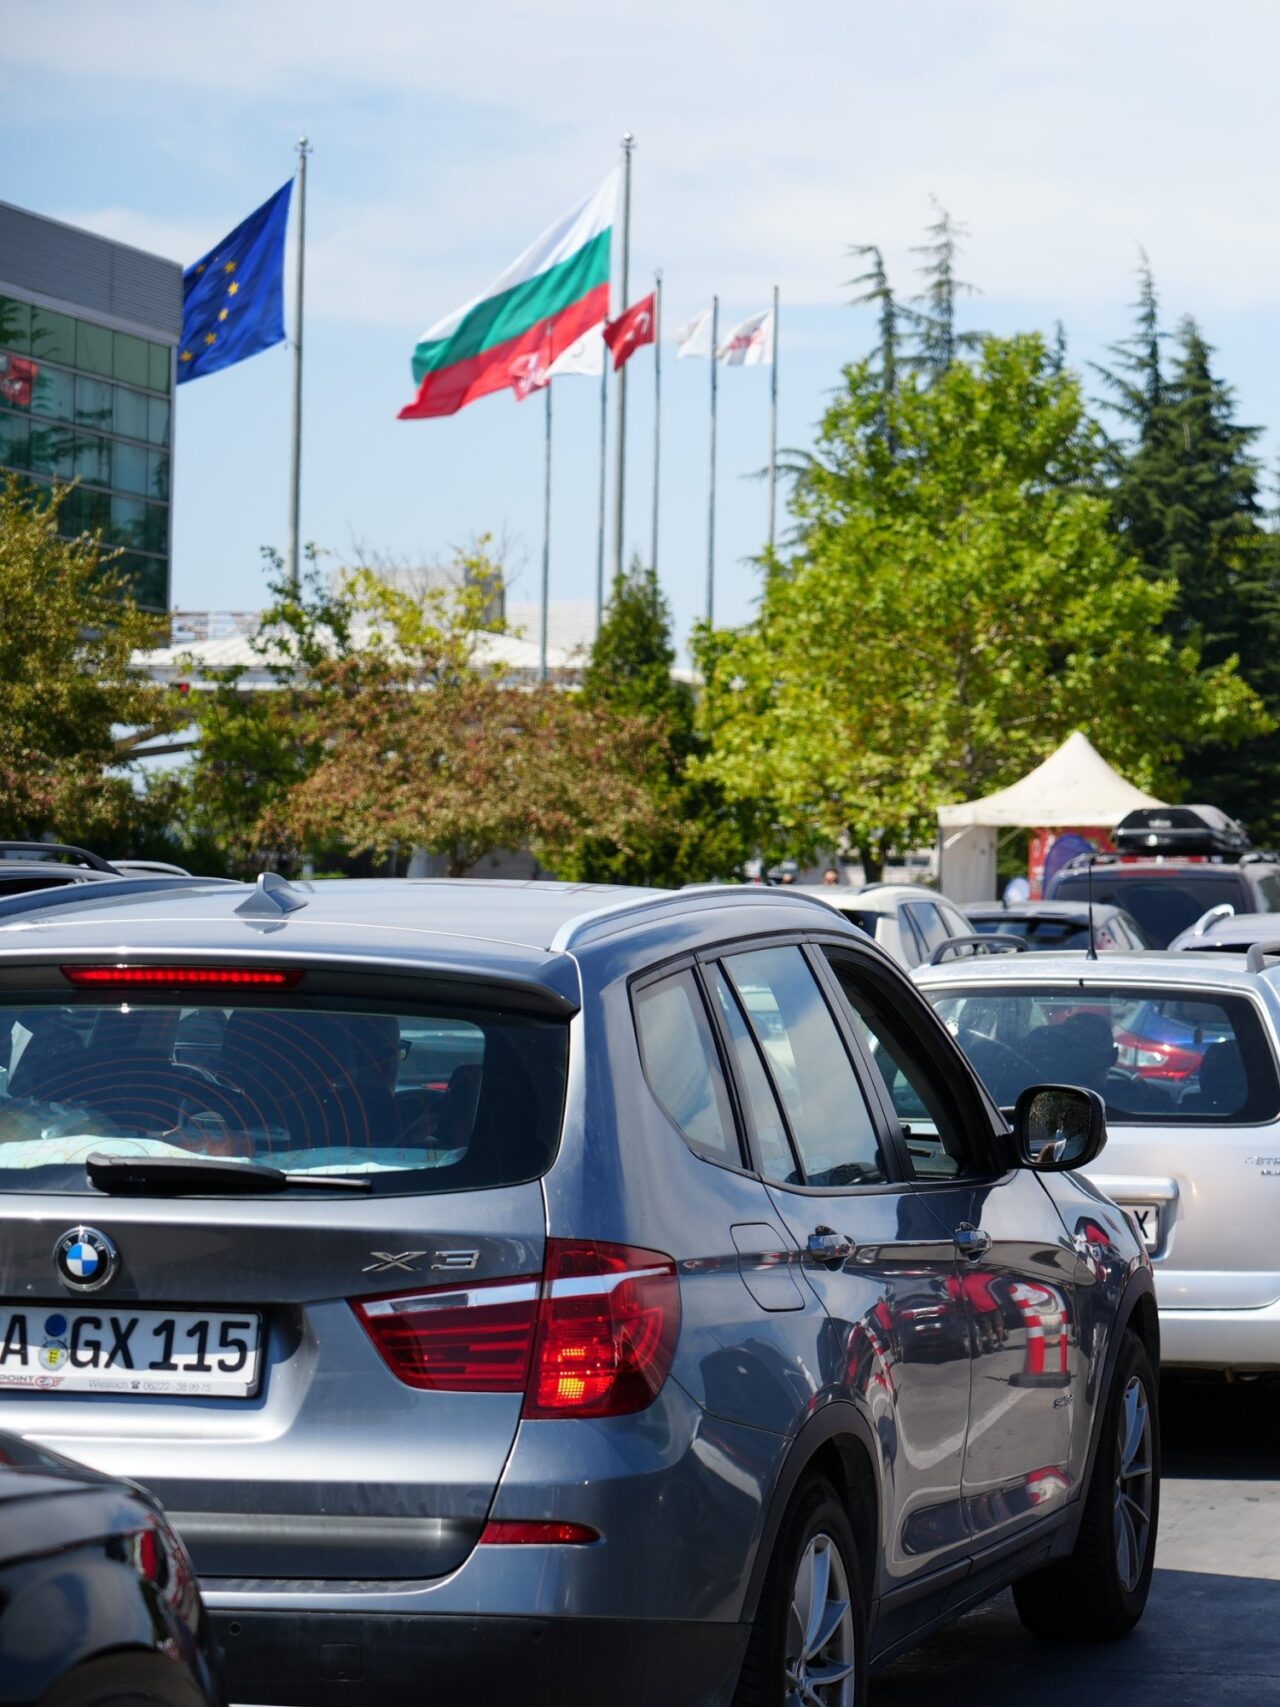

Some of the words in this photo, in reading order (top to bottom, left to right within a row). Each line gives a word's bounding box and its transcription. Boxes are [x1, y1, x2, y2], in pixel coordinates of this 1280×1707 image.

[62, 1233, 105, 1252] BMW
[361, 1250, 481, 1272] X3
[70, 1316, 139, 1369] GX
[149, 1318, 251, 1373] 115
